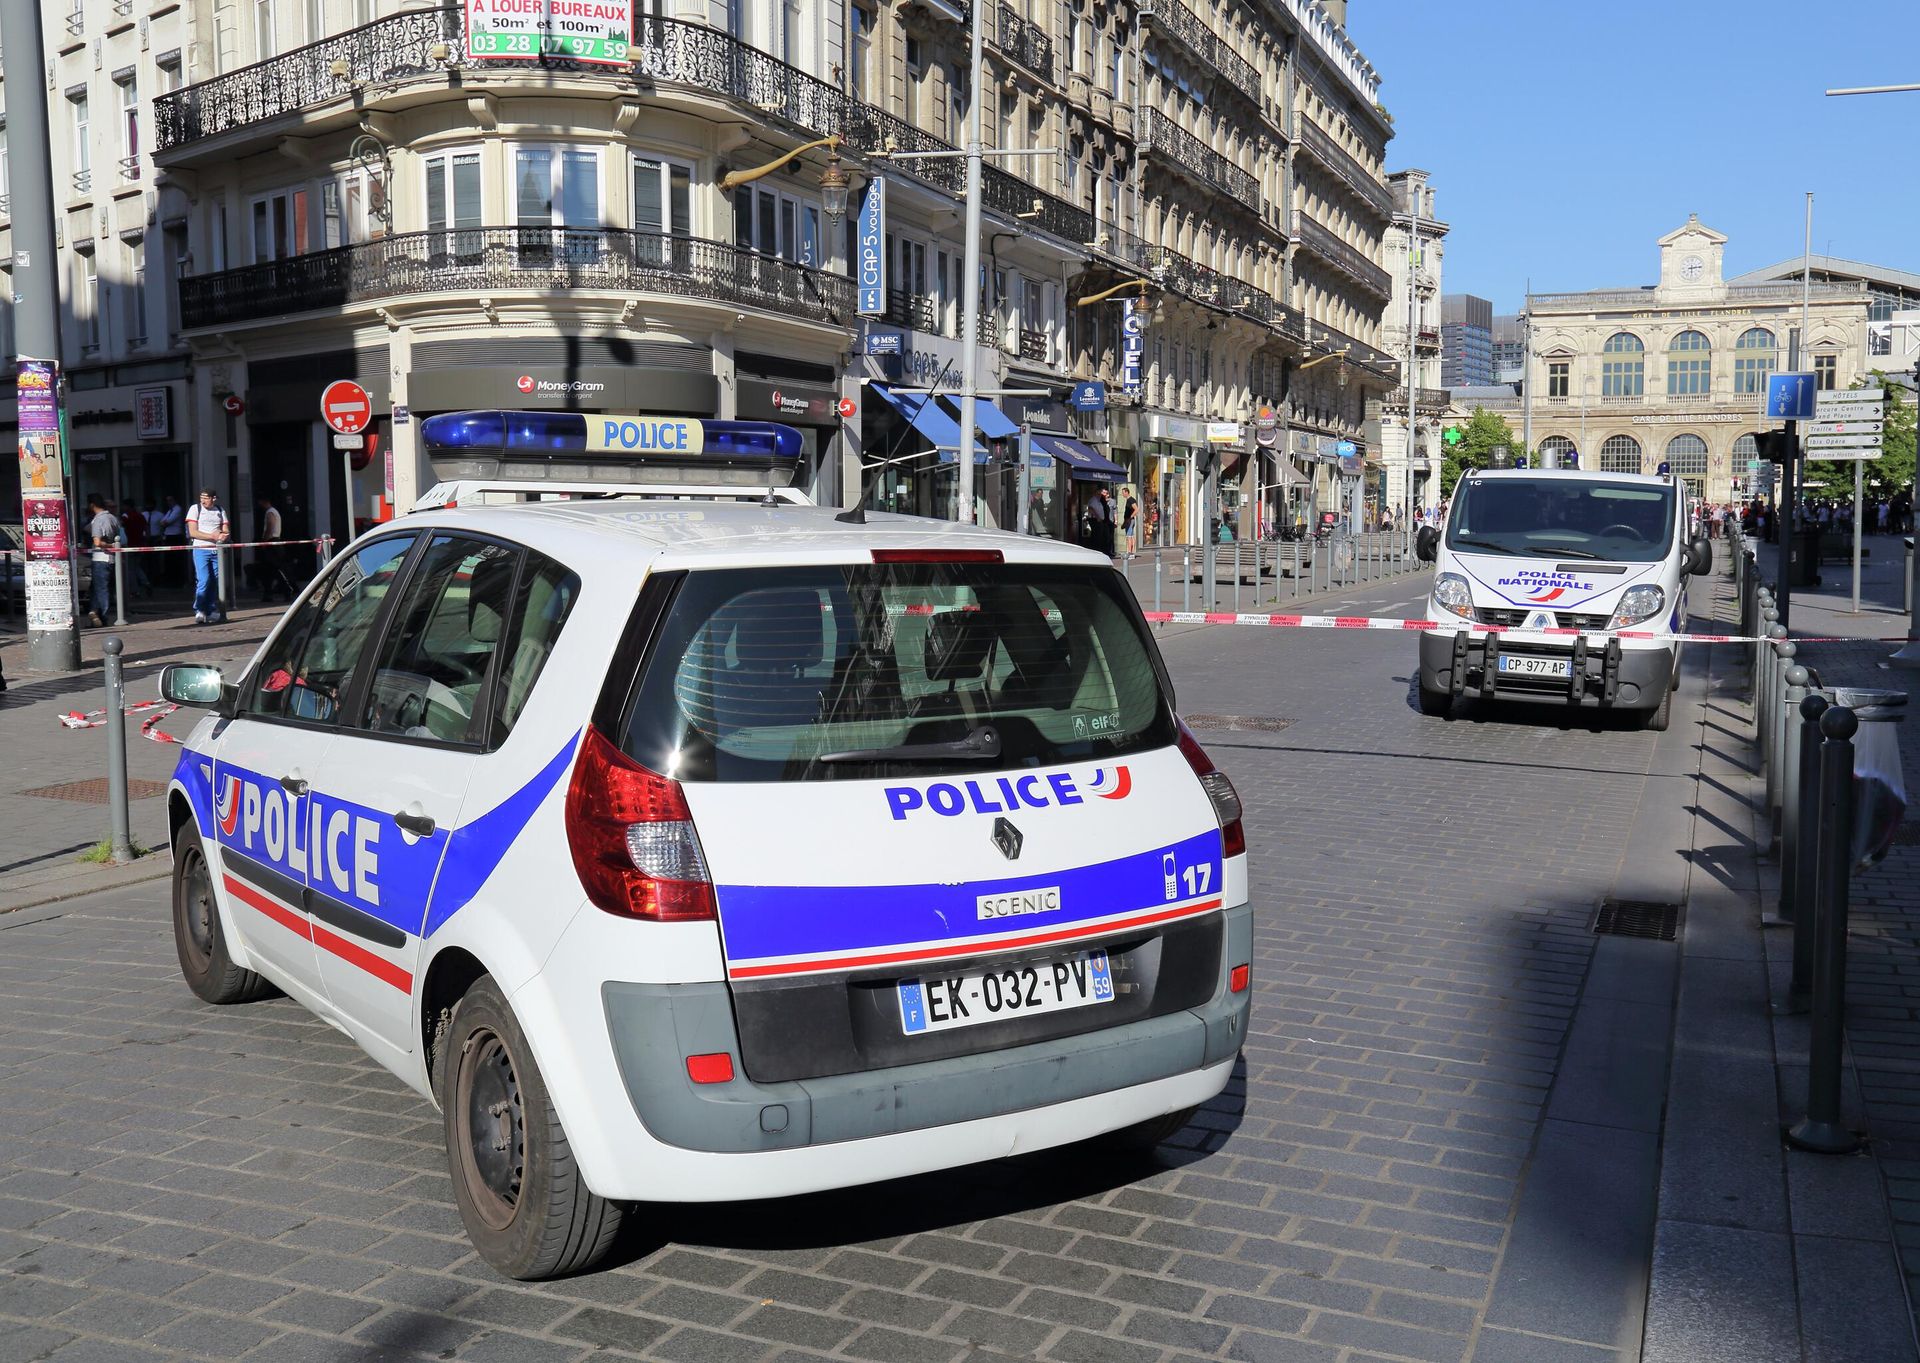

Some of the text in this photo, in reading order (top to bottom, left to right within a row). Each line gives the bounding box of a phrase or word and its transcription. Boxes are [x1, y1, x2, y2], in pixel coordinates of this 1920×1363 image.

[492, 0, 543, 14] LOUER
[551, 1, 626, 21] BUREAUX
[536, 21, 552, 30] et
[474, 35, 497, 51] 03
[506, 35, 531, 51] 28
[572, 38, 595, 55] 97
[603, 43, 627, 58] 59
[863, 235, 878, 247] 5
[863, 248, 878, 285] CAP
[880, 336, 899, 344] MSC
[537, 381, 605, 393] MoneyGram
[1023, 406, 1051, 425] Leonidas
[1632, 415, 1656, 423] GARE
[1674, 414, 1693, 422] LILLE
[1698, 413, 1743, 421] FLANDRES
[604, 421, 688, 449] POLICE
[1498, 578, 1594, 591] NATIONALE
[1518, 571, 1577, 581] POLICE
[1508, 660, 1566, 674] CP-977-AP
[1091, 715, 1109, 729] elf
[884, 773, 1084, 820] POLICE
[244, 781, 380, 906] POLICE
[1183, 863, 1212, 896] 17
[983, 892, 1058, 918] SCENIC
[910, 959, 1111, 1023] F EK-032-PV 59
